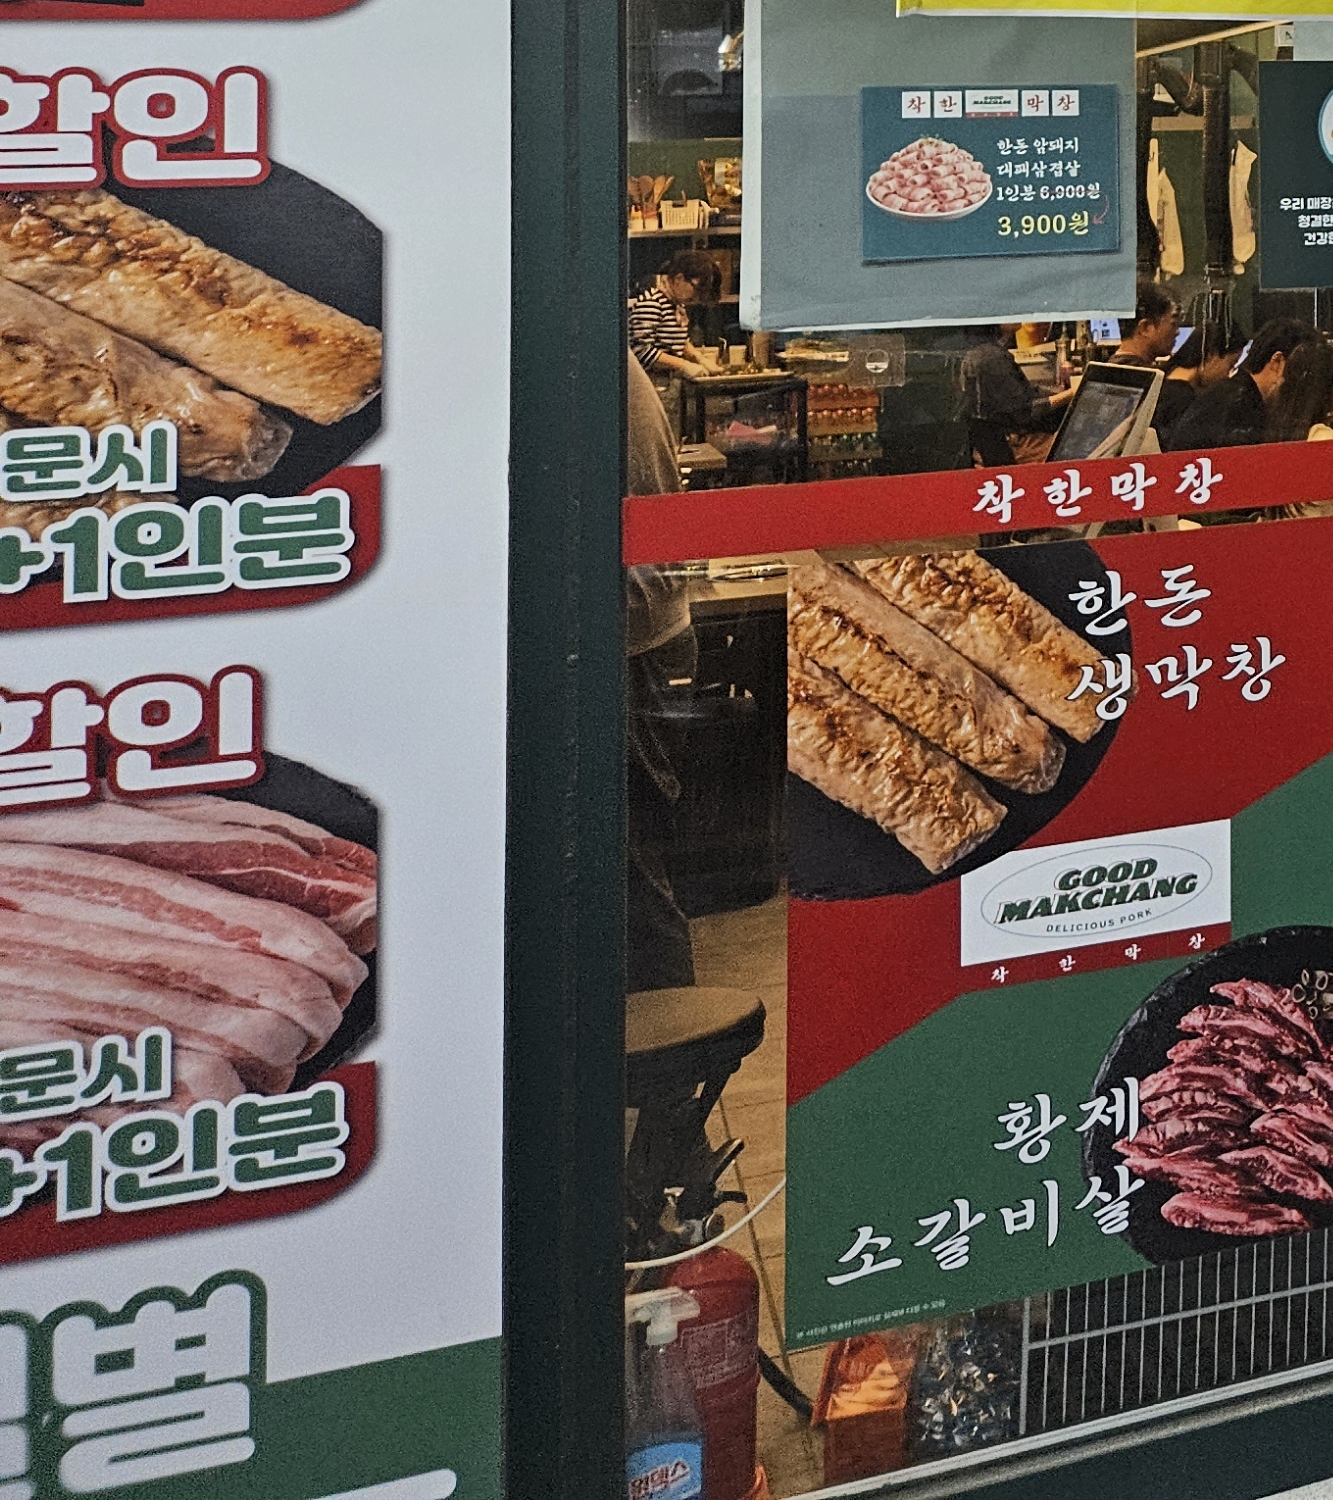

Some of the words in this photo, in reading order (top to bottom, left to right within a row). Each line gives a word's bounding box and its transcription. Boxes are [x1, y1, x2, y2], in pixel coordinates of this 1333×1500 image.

[996, 137, 1029, 155] 한돈
[1033, 136, 1079, 155] 암돼지
[996, 159, 1081, 179] 대패삼겹살
[996, 183, 1036, 202] 1인분
[1039, 181, 1101, 201] 6,900원
[1279, 197, 1305, 211] 우리
[997, 210, 1089, 239] 3,900원
[1068, 563, 1213, 638] 한돈
[1067, 636, 1287, 722] 생막창
[1053, 856, 1159, 892] GOOD
[992, 872, 1199, 925] MAKCHANG
[1046, 919, 1116, 933] DELICIOUS
[1119, 908, 1153, 925] PORK
[992, 1077, 1142, 1165] 황제
[826, 1165, 1146, 1288] 소갈비살
